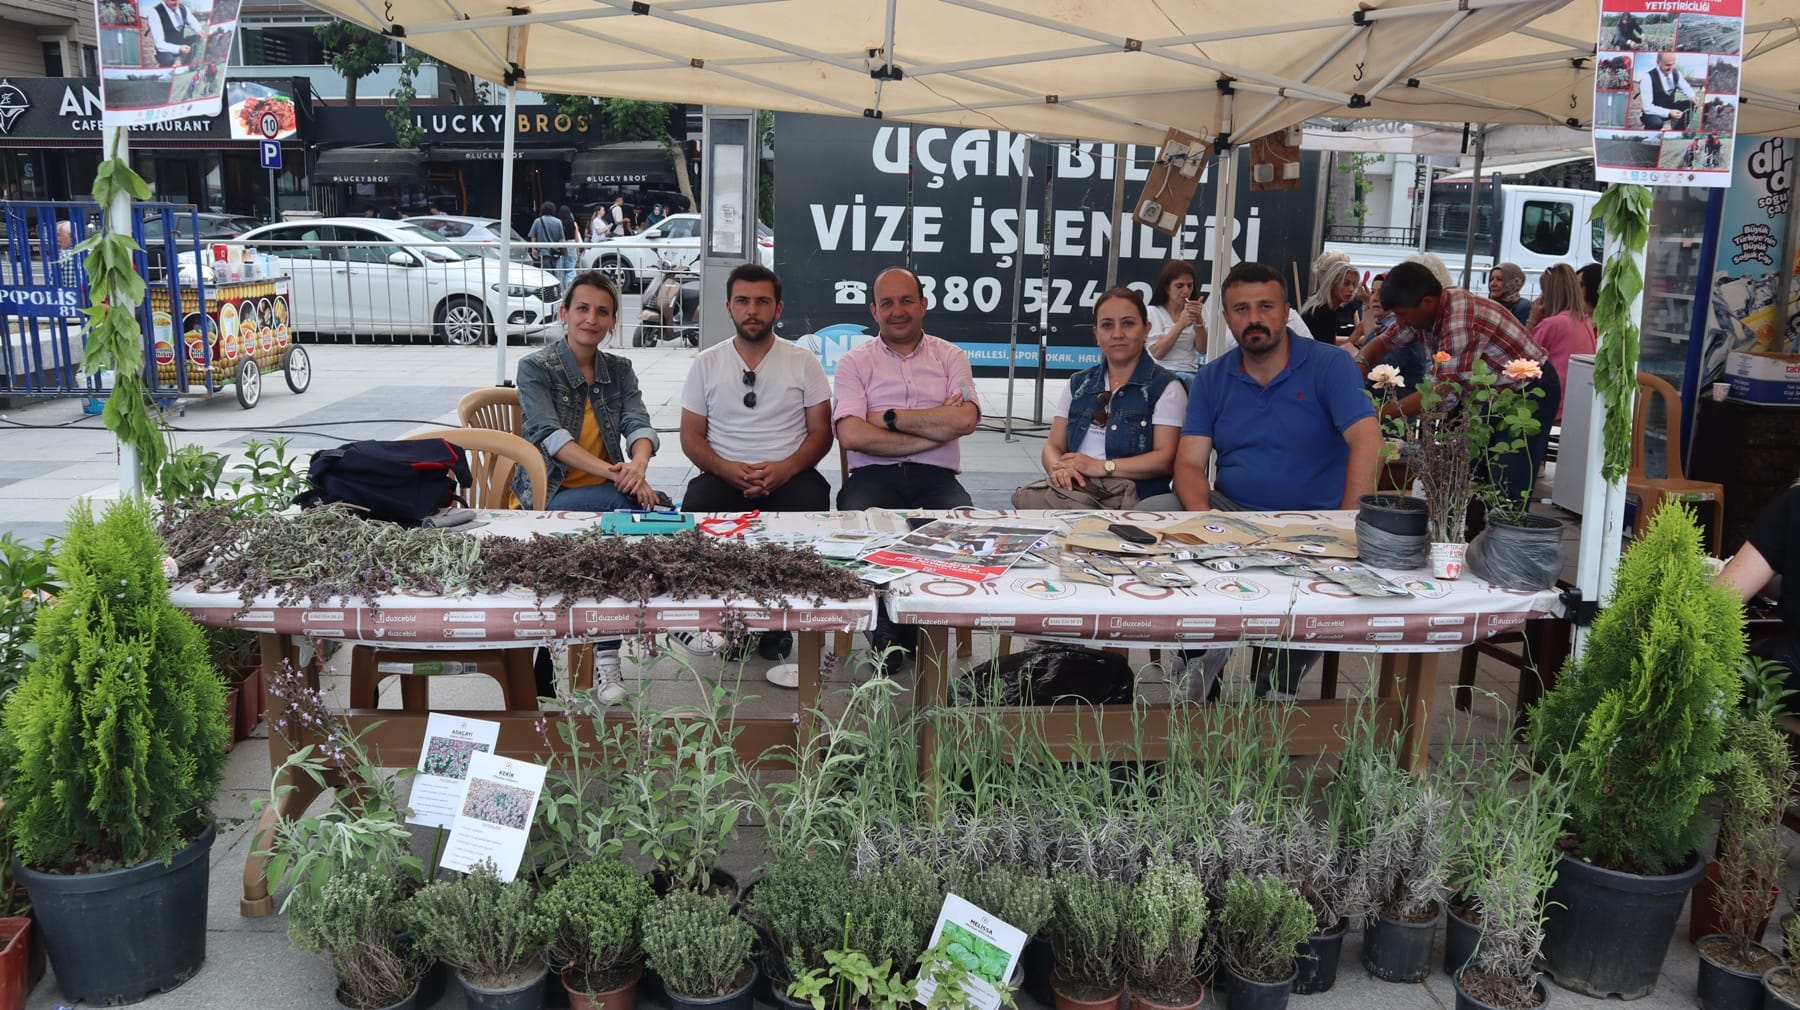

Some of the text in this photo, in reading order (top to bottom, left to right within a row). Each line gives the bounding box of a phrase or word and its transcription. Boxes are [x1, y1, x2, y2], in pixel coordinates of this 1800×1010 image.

[72, 120, 103, 131] CAFE
[264, 119, 275, 132] 10
[417, 114, 503, 133] LUCKY
[264, 143, 277, 165] P
[872, 126, 1035, 190] UÇAK
[809, 194, 944, 253] VİZE
[16, 288, 77, 306] POLİS
[1023, 277, 1104, 315] 524
[60, 305, 77, 317] 81
